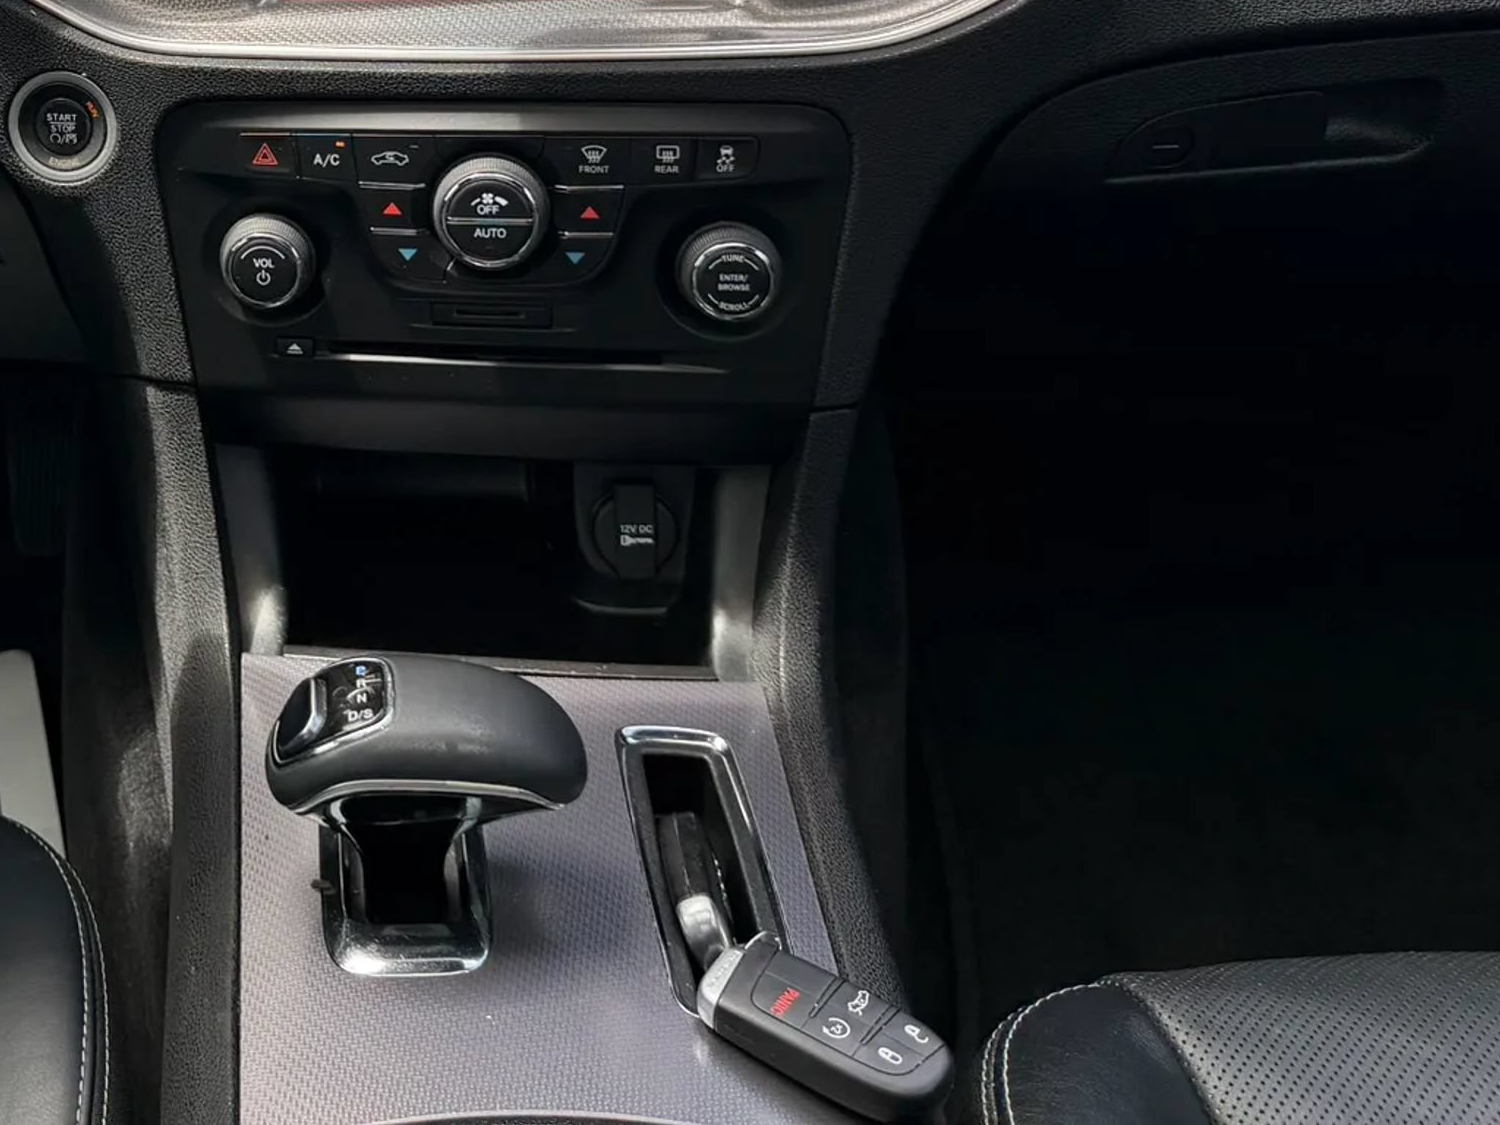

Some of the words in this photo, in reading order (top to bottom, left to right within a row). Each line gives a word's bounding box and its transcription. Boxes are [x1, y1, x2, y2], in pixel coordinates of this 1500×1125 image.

[46, 112, 77, 122] START
[50, 124, 76, 133] STOP
[313, 153, 341, 168] A/C
[578, 165, 610, 174] FRONT
[654, 165, 679, 174] REAR
[715, 164, 735, 173] OFF
[476, 204, 500, 215] OFF
[473, 227, 507, 238] AUTO
[253, 257, 275, 268] VOL
[721, 253, 746, 263] TUNE
[717, 283, 751, 292] BROWSE
[620, 524, 637, 534] 12V
[638, 524, 654, 534] DC
[356, 692, 367, 703] N
[348, 708, 373, 722] D/S
